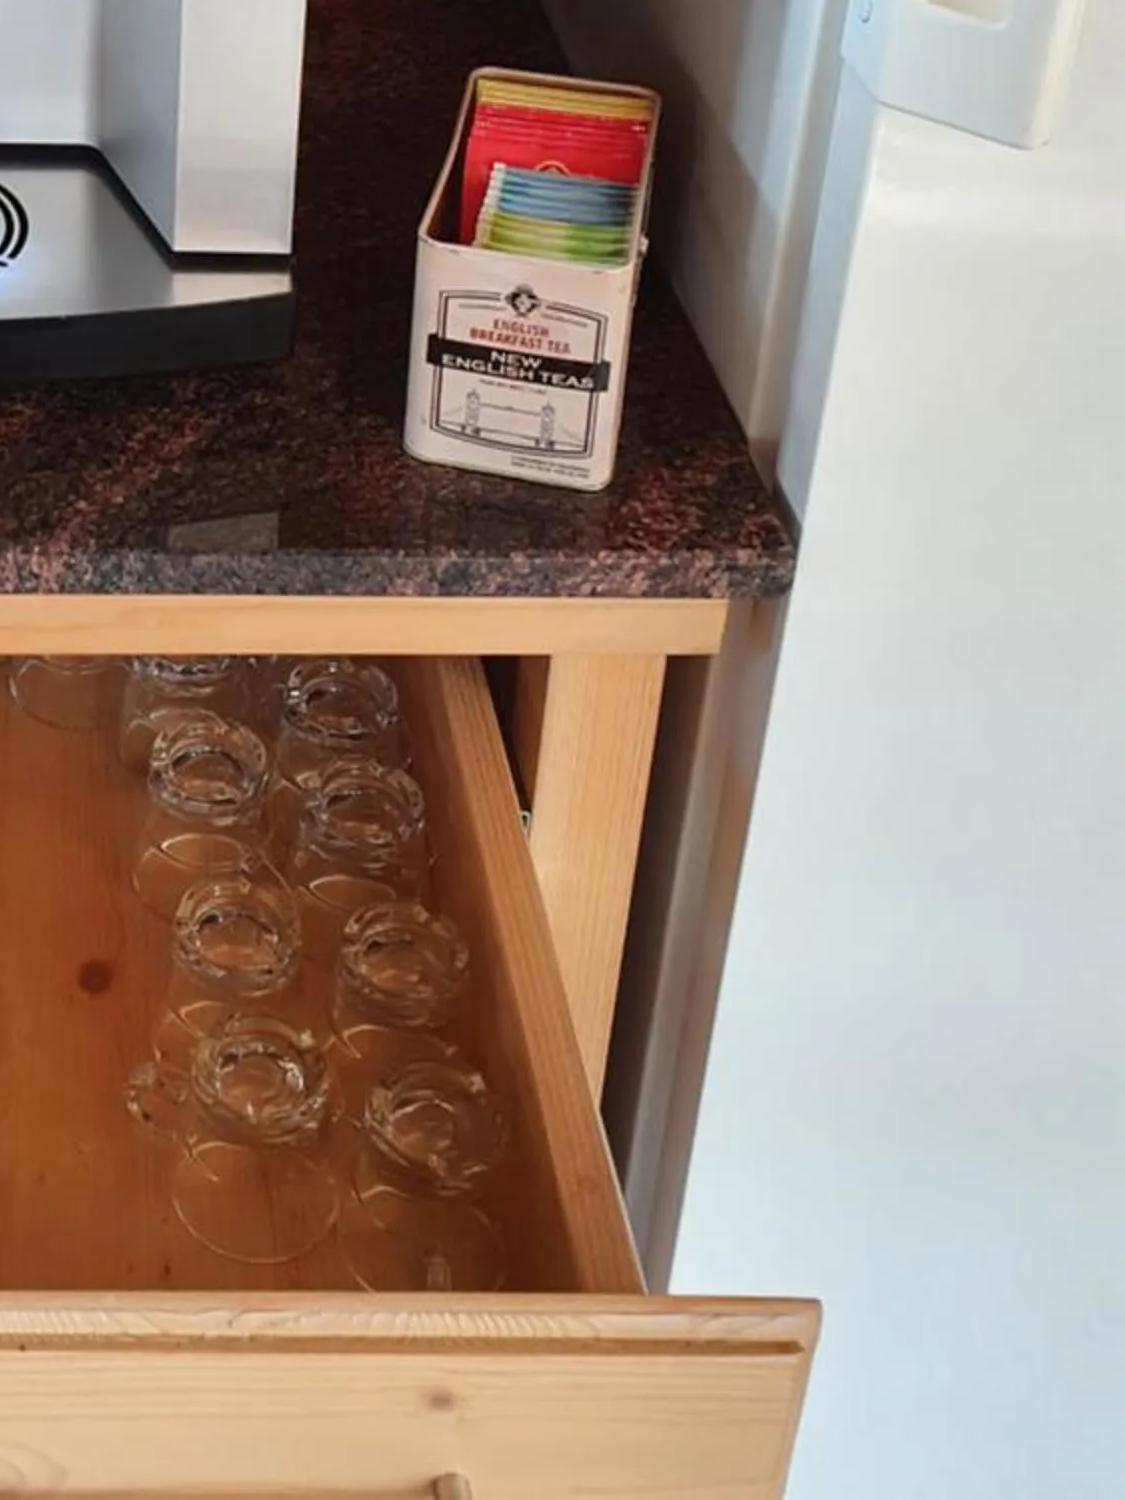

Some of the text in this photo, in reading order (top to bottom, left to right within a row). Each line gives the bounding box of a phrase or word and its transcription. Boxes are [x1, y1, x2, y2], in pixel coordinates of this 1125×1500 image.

[492, 318, 550, 337] ENGLISH
[469, 327, 572, 354] BREAKFAST TEA
[441, 353, 535, 381] ENGLISH
[538, 371, 595, 390] TEAS
[490, 350, 542, 370] NEW
